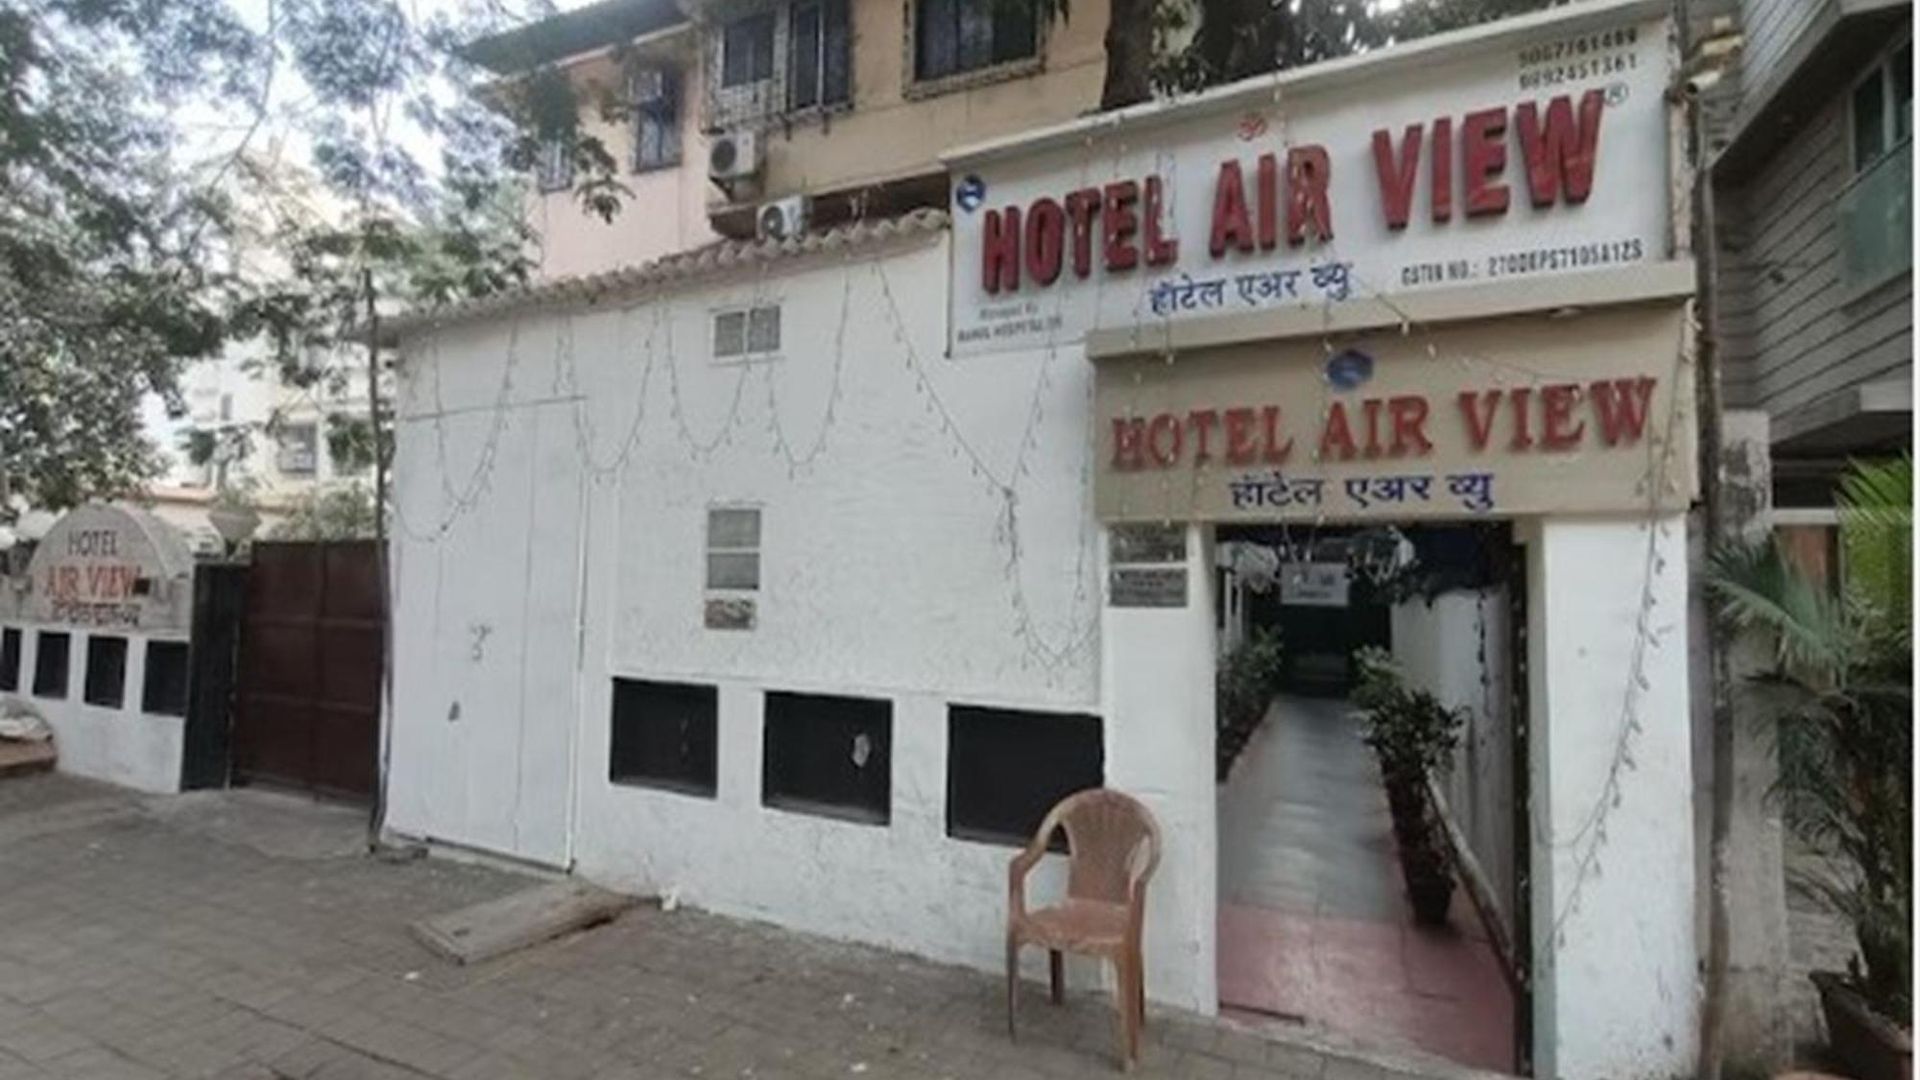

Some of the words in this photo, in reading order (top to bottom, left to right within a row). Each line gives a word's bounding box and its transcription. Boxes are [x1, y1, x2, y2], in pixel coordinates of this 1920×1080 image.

[983, 173, 1178, 295] HOTEL
[1208, 144, 1334, 260] AIR
[1372, 88, 1605, 231] VIEW
[1235, 270, 1301, 305] एअर
[1111, 406, 1294, 473] HOTEL
[1319, 396, 1433, 461] AIR
[1457, 377, 1656, 453] VIEW
[1345, 475, 1432, 508] एअर
[67, 530, 118, 557] HOTEL
[44, 565, 80, 597] AIR
[86, 564, 142, 597] VIEW
